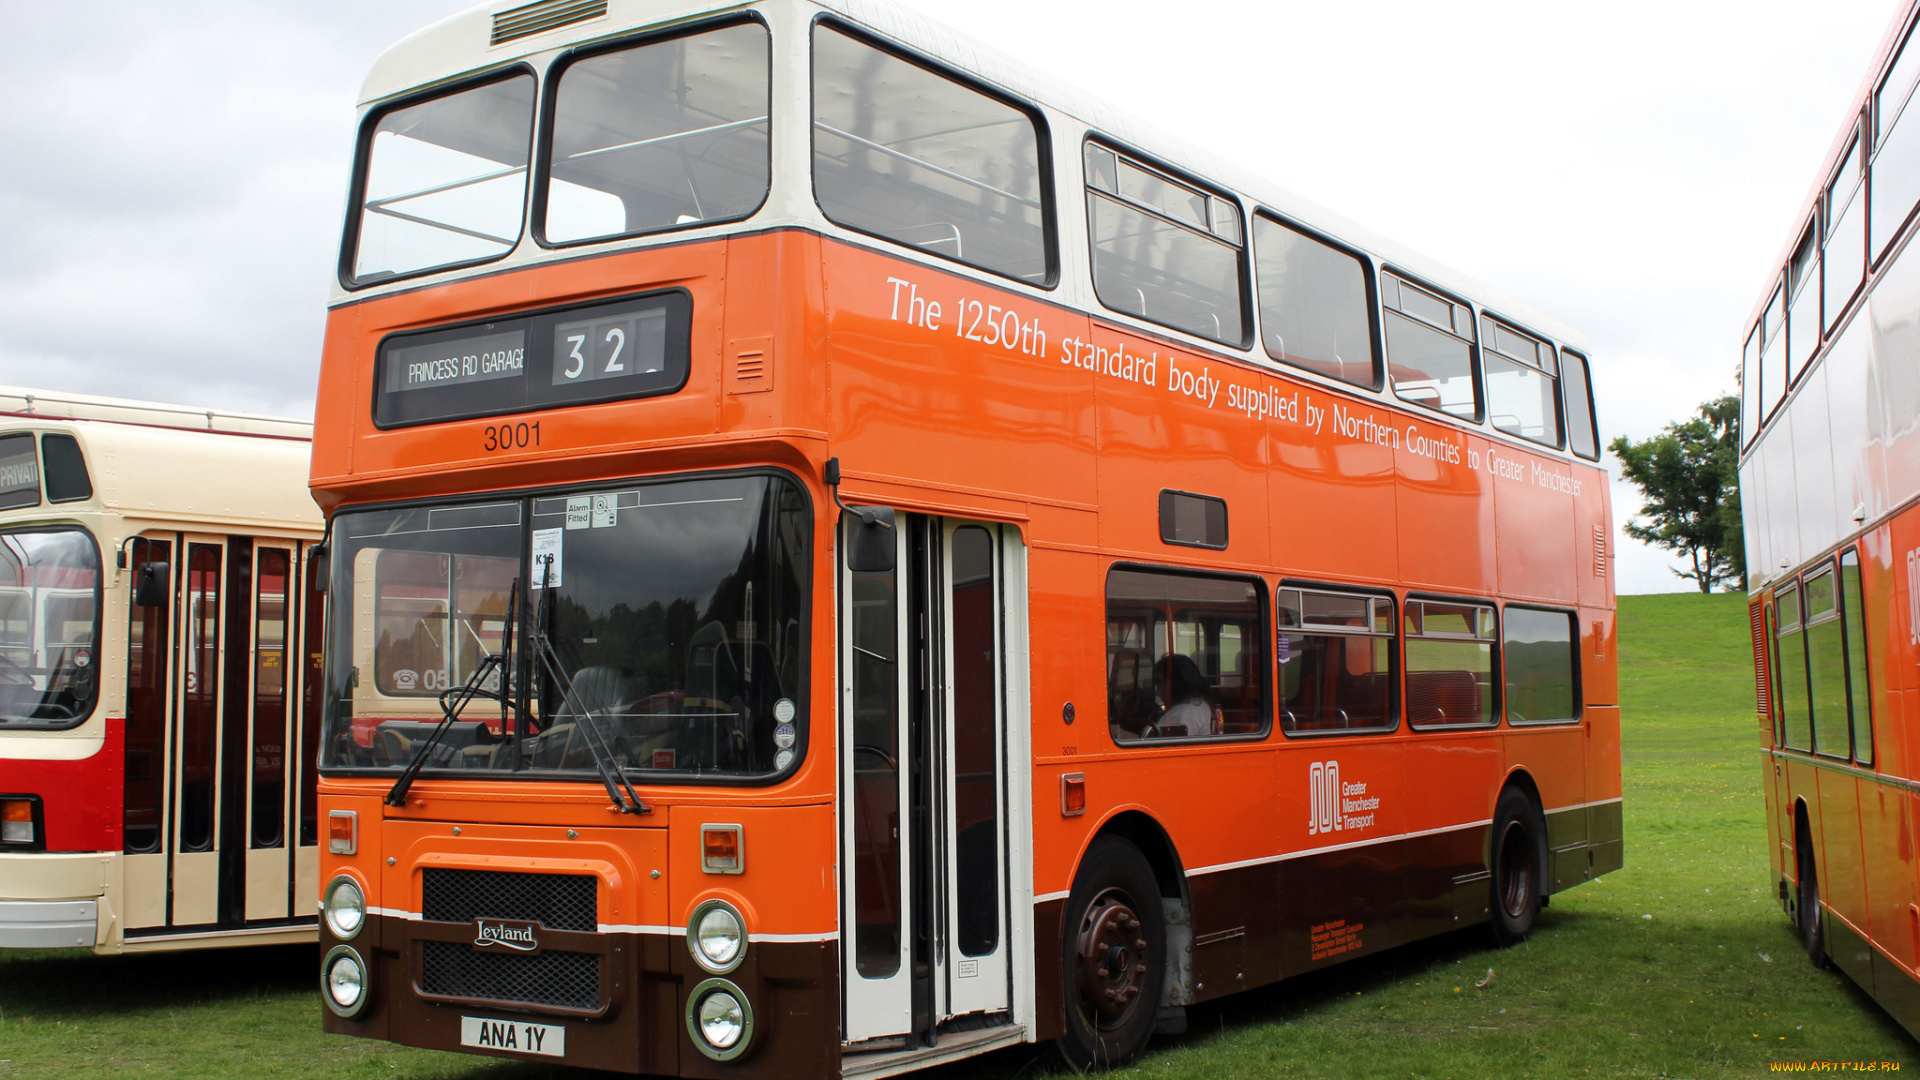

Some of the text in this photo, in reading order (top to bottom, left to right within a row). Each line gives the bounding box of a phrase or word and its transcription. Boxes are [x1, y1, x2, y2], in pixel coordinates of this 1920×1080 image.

[409, 348, 524, 384] PRINCESS RD GARAGE
[886, 276, 1583, 498] The 1250th standard body supplied by Northern Counties to Greater Manchester
[484, 421, 540, 451] 3001
[568, 504, 589, 512] Alarm
[568, 514, 588, 523] Fitted
[1342, 781, 1367, 796] Greater
[1342, 796, 1380, 813] Manchester
[1343, 812, 1375, 831] Transport
[475, 920, 538, 950] Leyland
[479, 1021, 546, 1051] ANA 1Y
